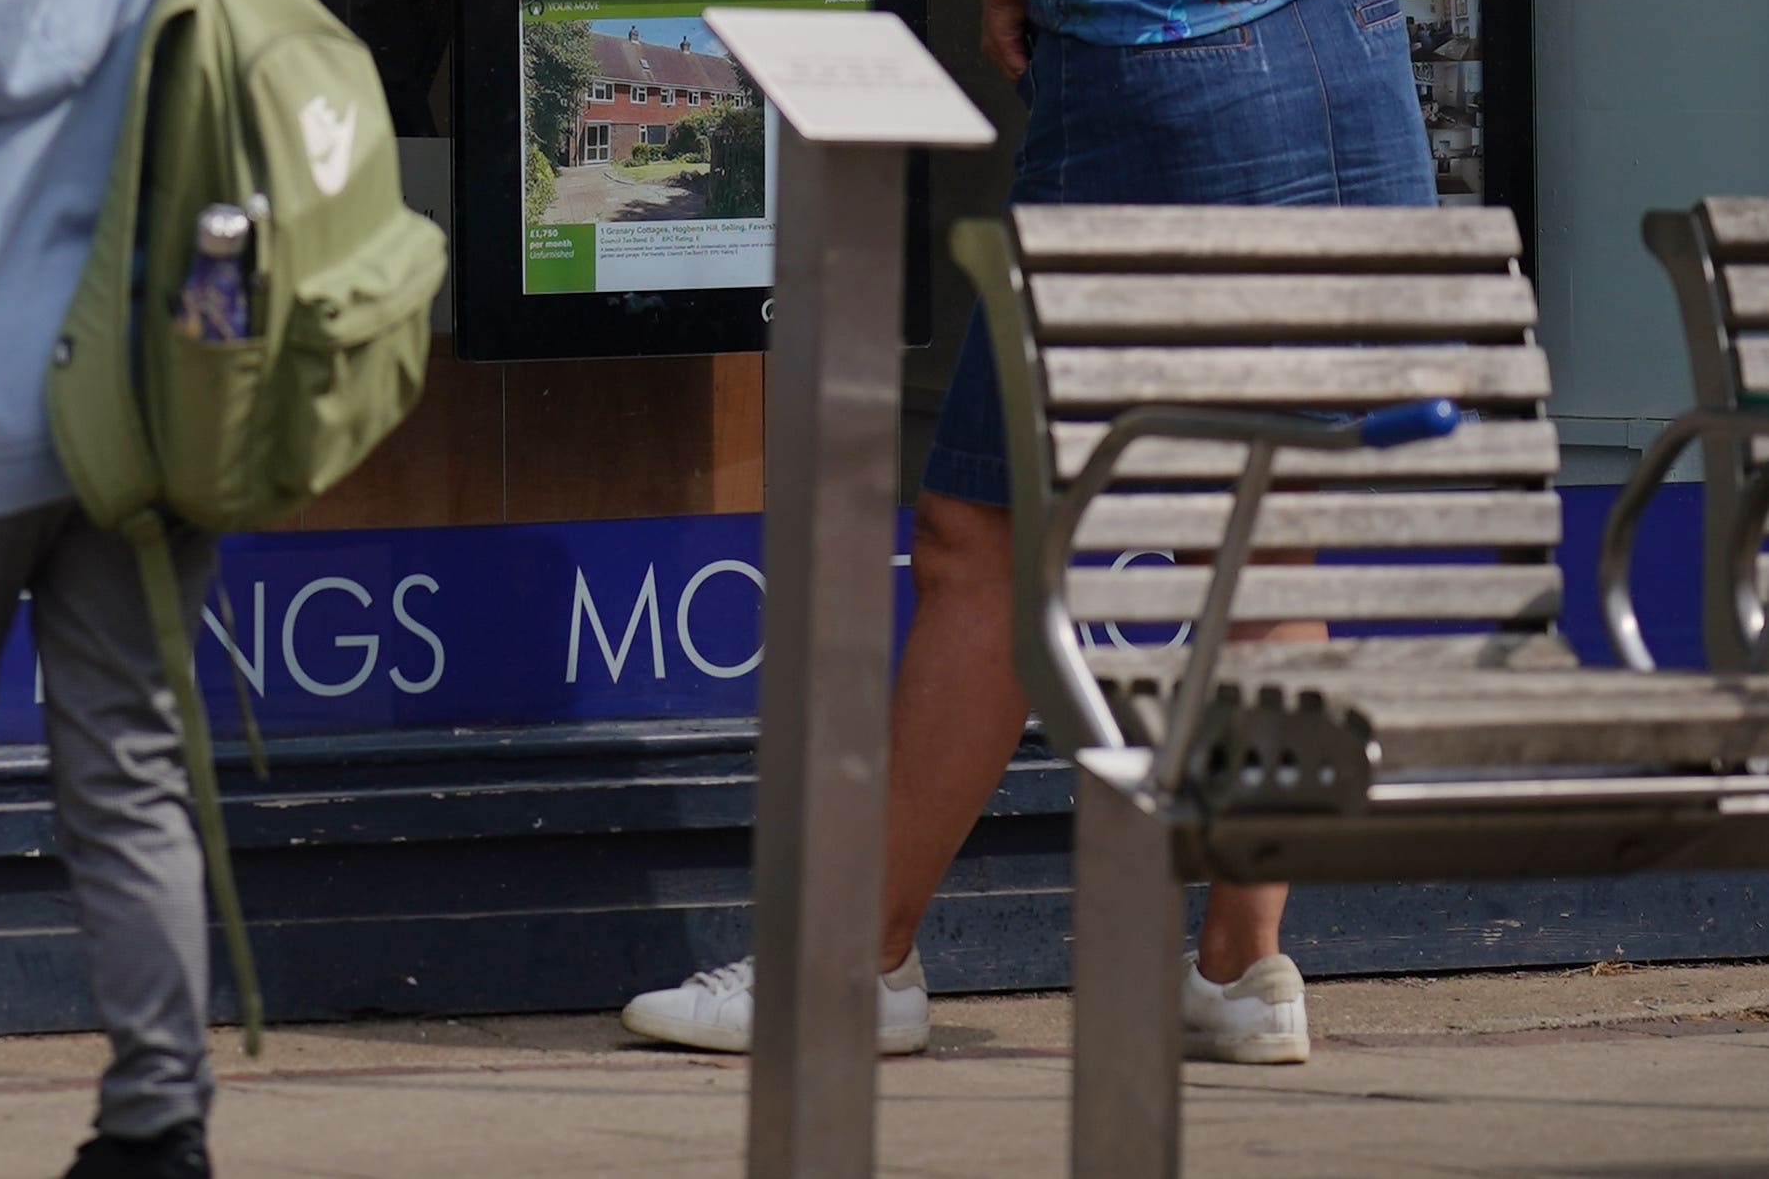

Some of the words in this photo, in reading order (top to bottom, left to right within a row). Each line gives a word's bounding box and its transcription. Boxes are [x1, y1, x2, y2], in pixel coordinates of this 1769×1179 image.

[548, 2, 572, 11] YOUR
[574, 2, 600, 11] MOVE
[606, 227, 634, 237] Granary
[672, 224, 703, 235] Hogbens
[529, 241, 543, 250] per
[545, 239, 572, 248] month
[529, 250, 574, 260] Unfurnished
